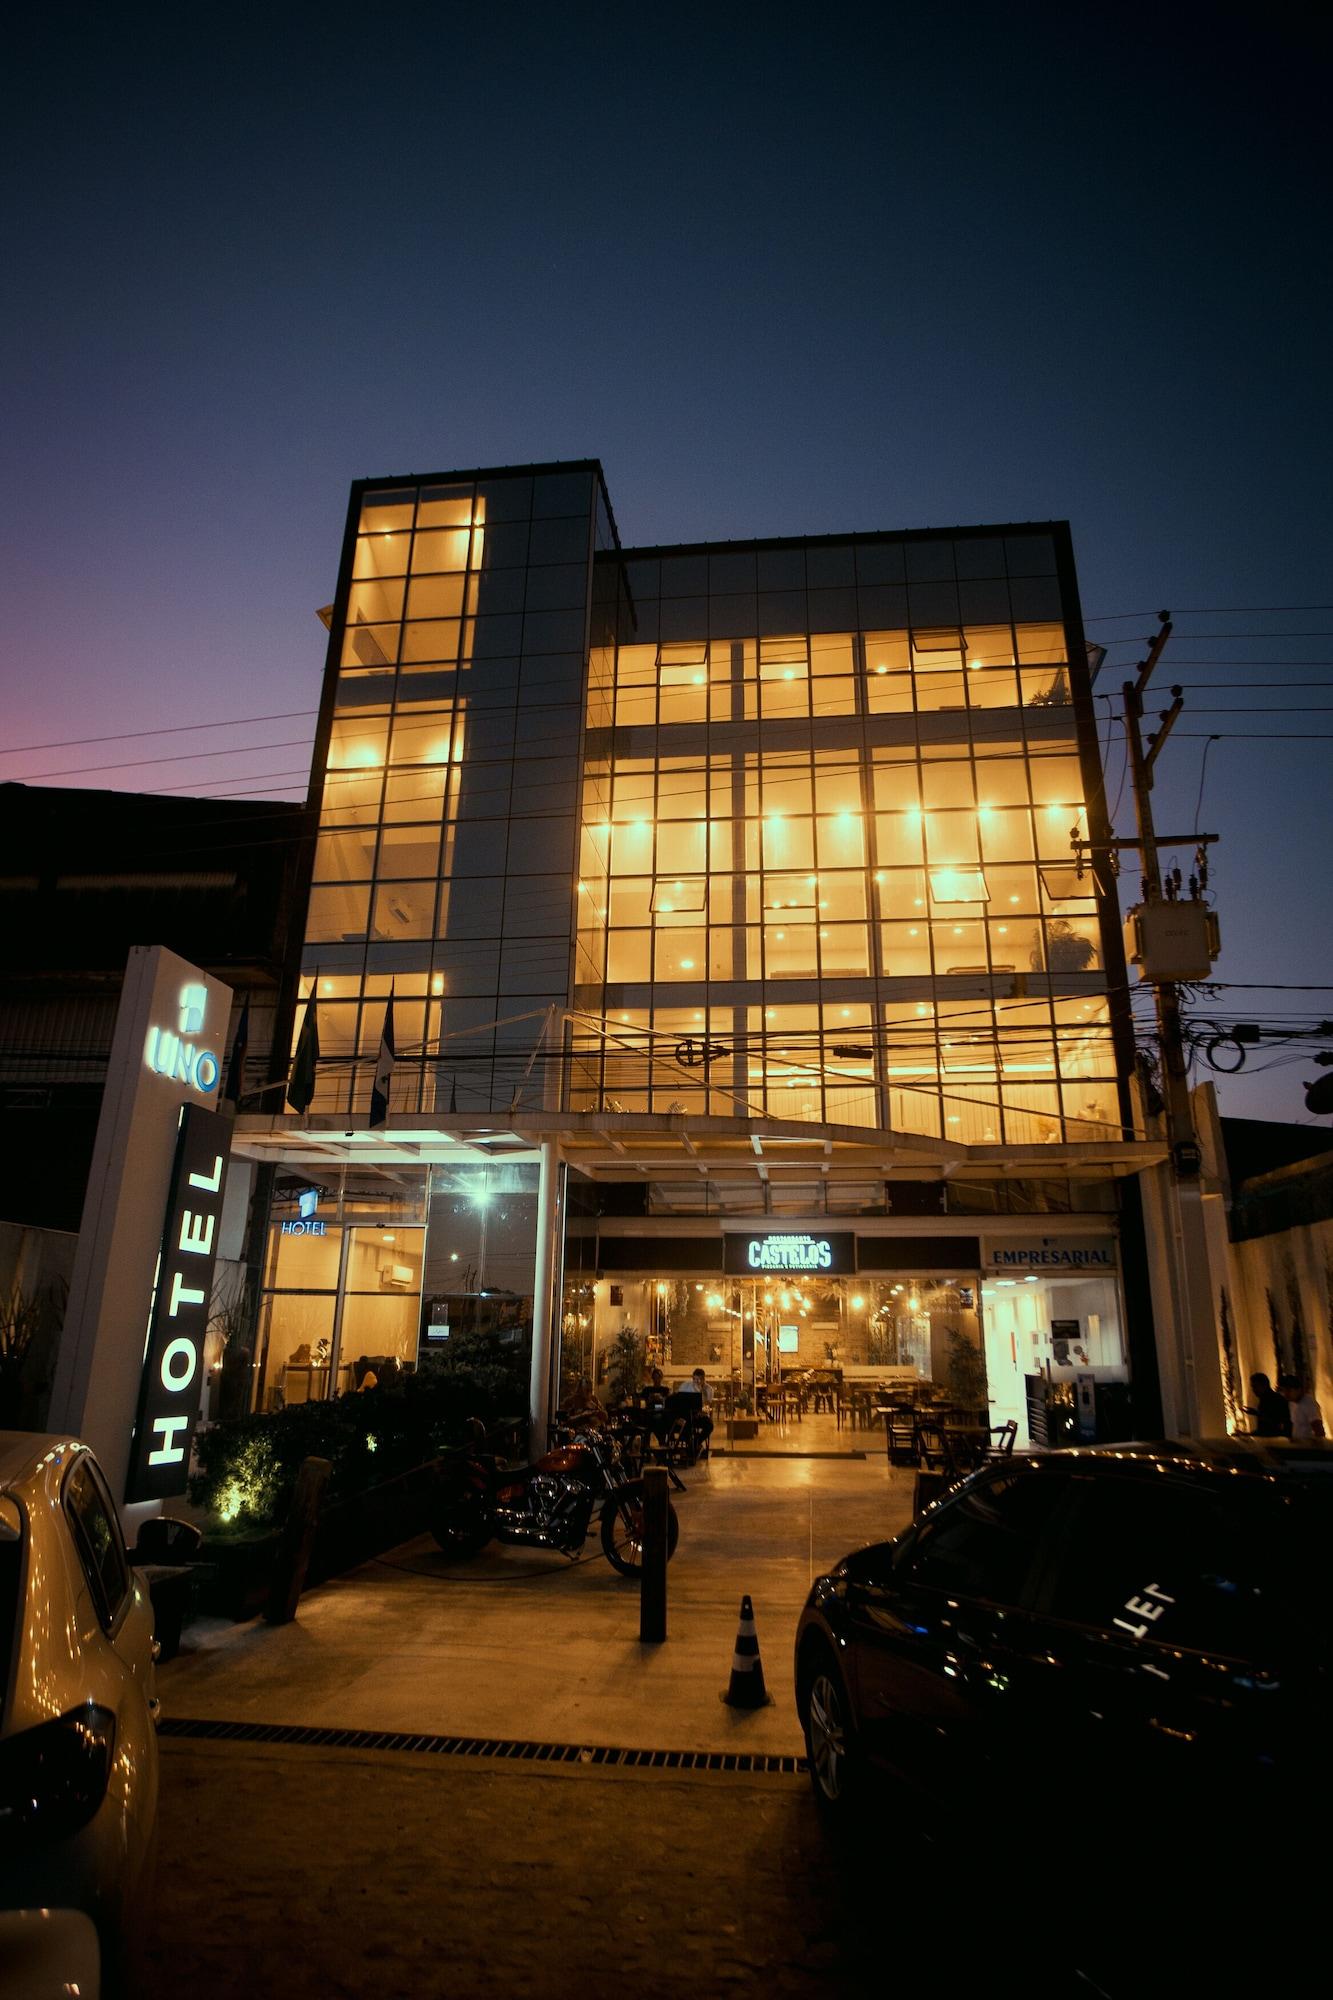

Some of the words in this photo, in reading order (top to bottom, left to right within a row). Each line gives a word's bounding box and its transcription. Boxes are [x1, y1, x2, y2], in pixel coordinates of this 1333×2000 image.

[146, 1026, 220, 1093] UNO
[281, 1221, 326, 1236] HOTEL
[993, 1250, 1111, 1264] EMPRESARIAL
[147, 1153, 224, 1467] HOTEL
